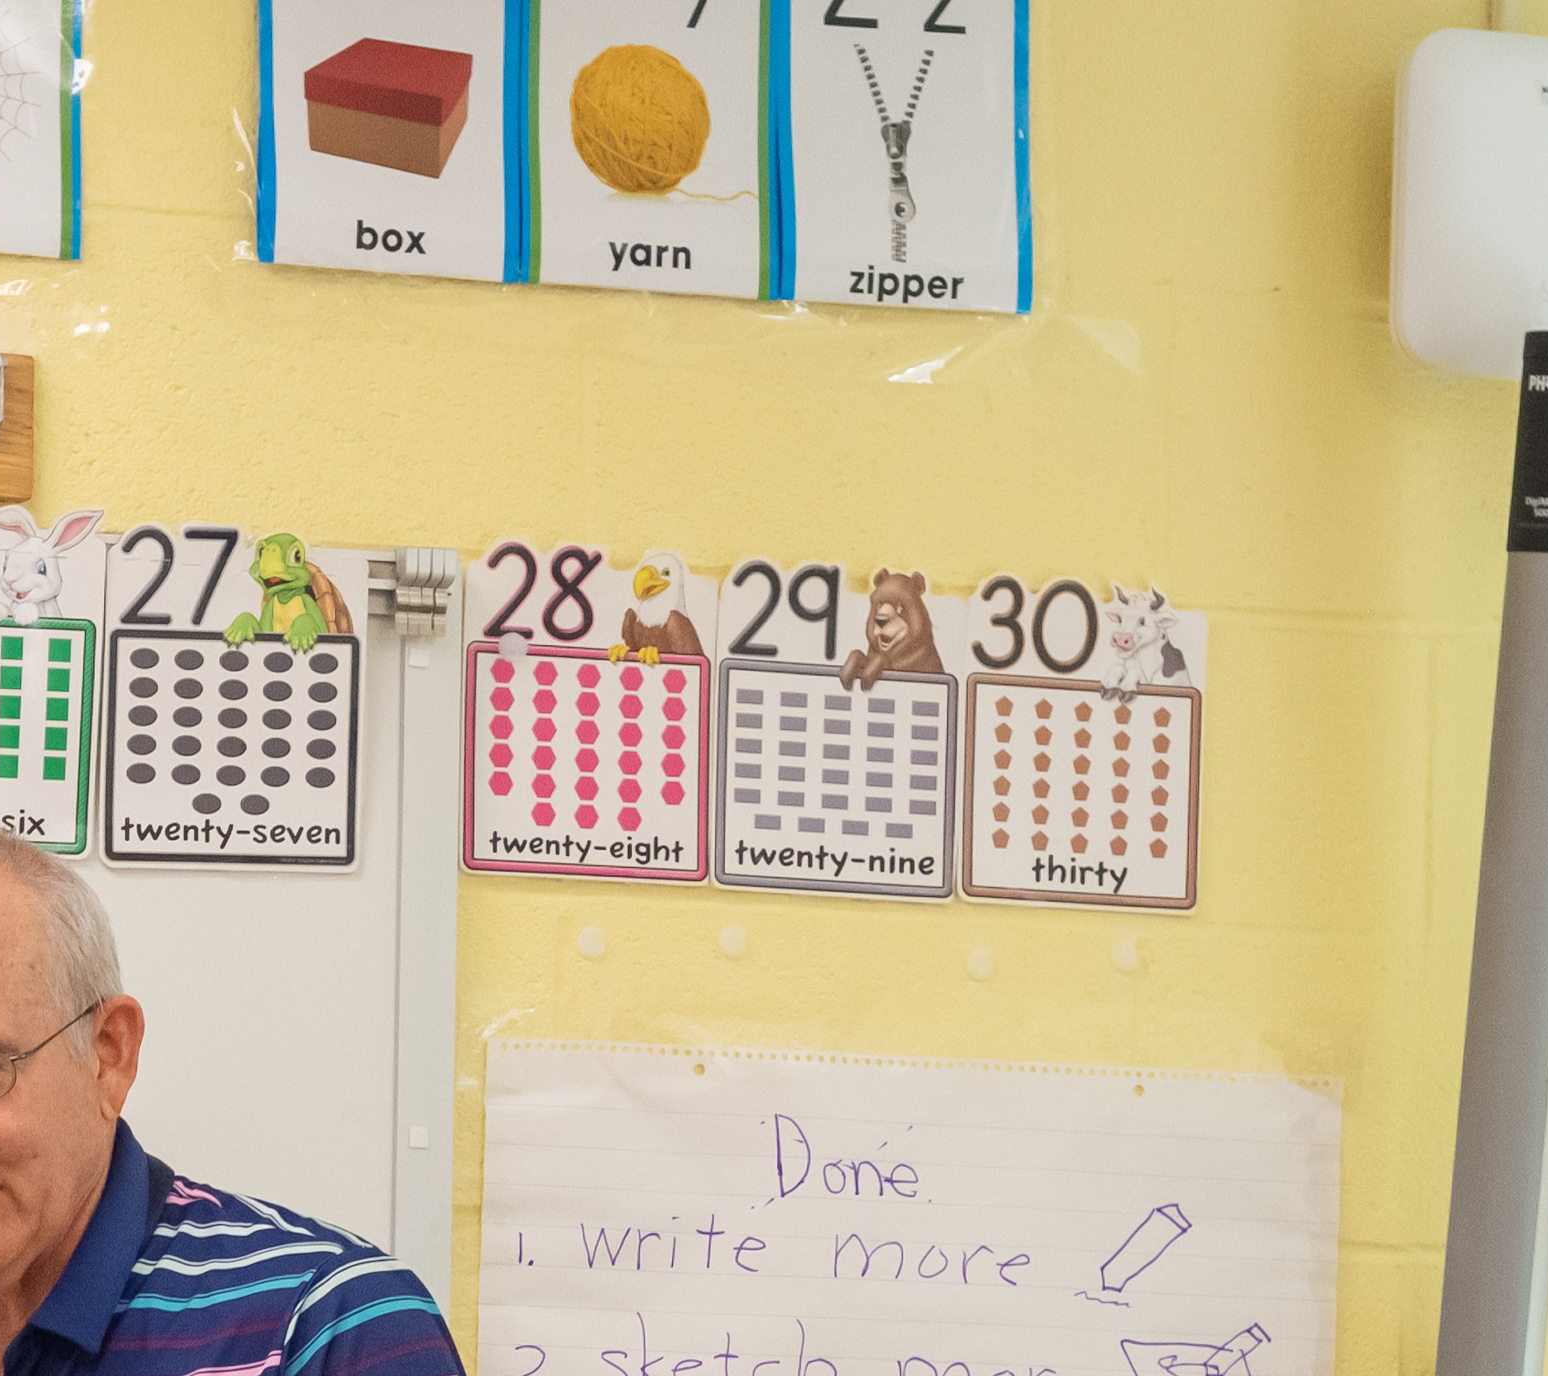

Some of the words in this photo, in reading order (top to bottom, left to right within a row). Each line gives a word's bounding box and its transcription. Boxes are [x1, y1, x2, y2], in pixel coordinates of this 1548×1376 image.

[355, 218, 427, 256] box
[608, 241, 692, 273] yarn
[848, 264, 965, 305] zipper
[119, 528, 239, 626] 27
[482, 544, 603, 642] 28
[728, 563, 841, 661] 29
[971, 578, 1099, 674] 30
[120, 816, 342, 851] twenty-seven
[486, 829, 685, 866] twenty-eight
[734, 838, 936, 884] twenty-nine
[1030, 853, 1128, 896] thirty
[774, 1112, 921, 1200] Done
[580, 1213, 769, 1276] write
[833, 1230, 1032, 1288] more
